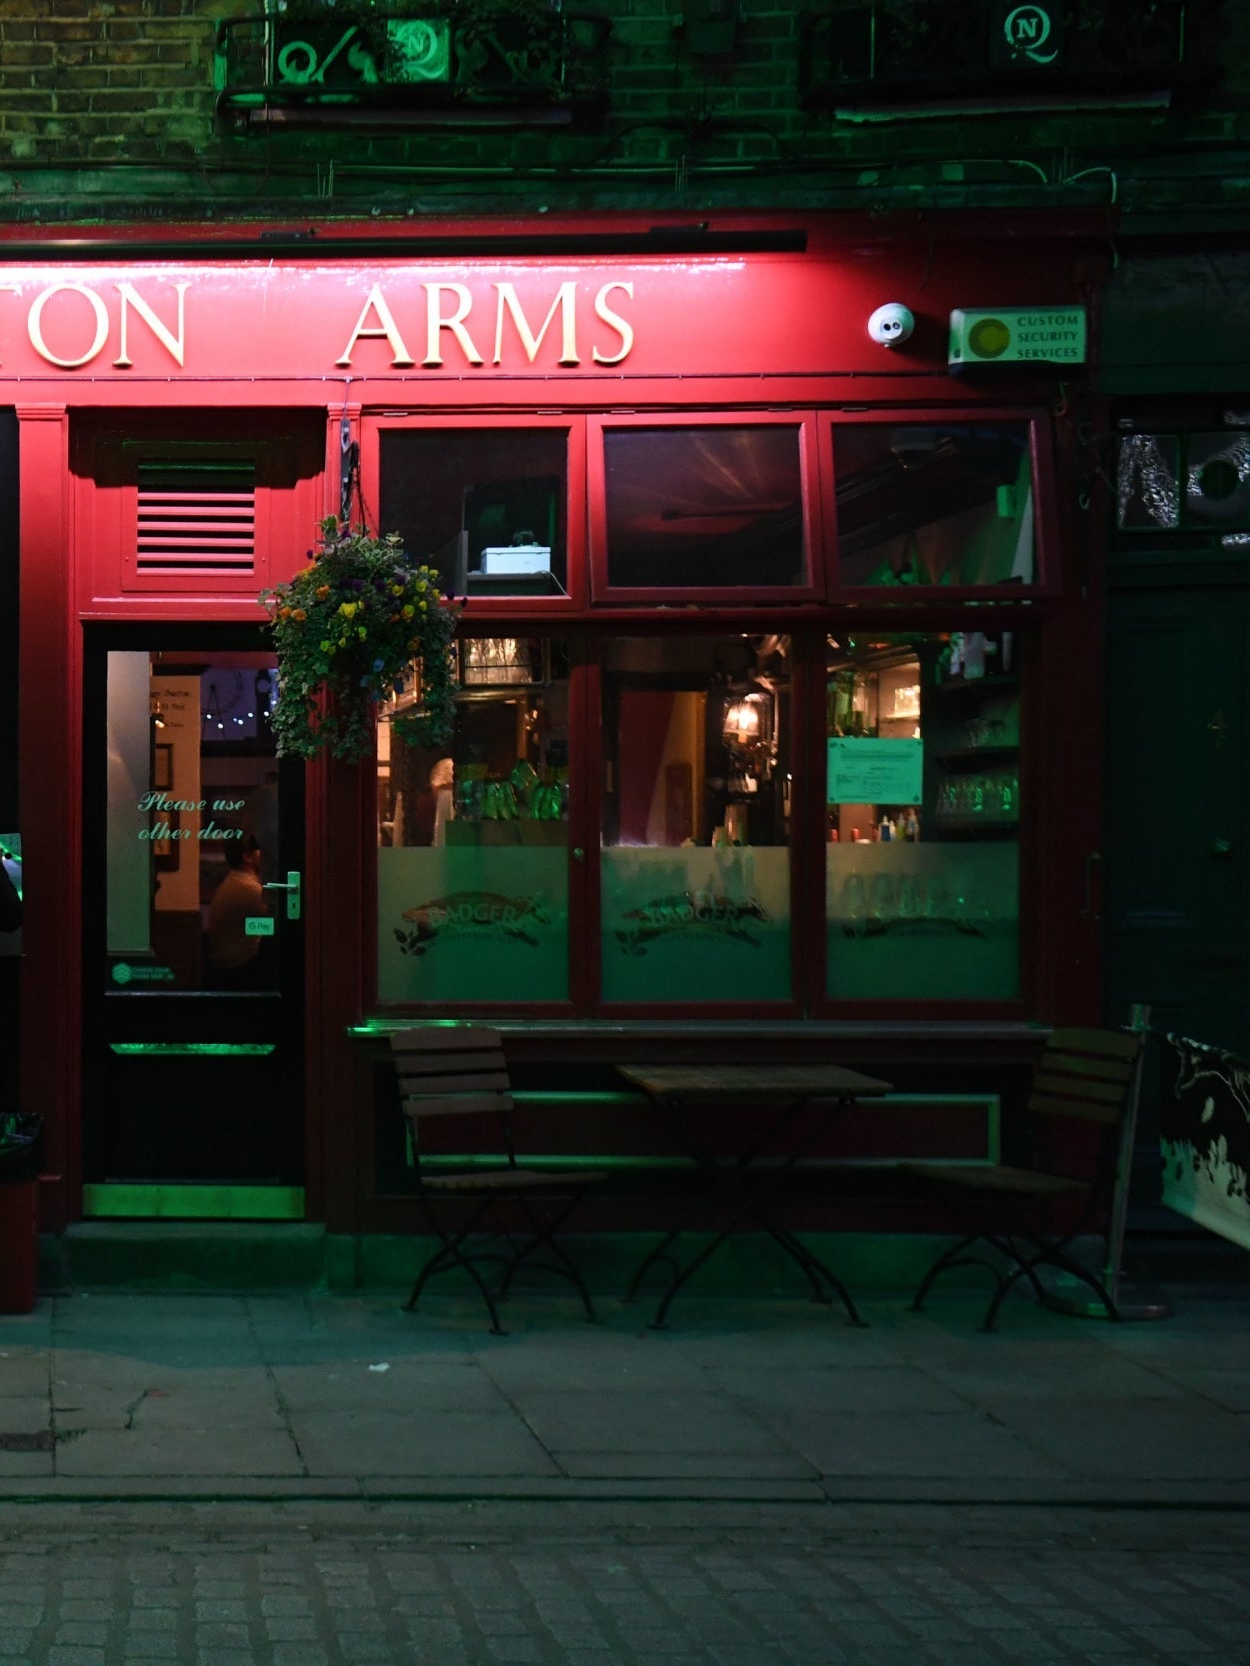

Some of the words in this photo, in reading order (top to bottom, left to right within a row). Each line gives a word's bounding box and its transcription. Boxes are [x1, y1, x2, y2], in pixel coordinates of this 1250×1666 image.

[334, 281, 634, 368] ARMS
[1017, 315, 1078, 326] CUSTOM
[1017, 331, 1078, 342] SECURITY
[1017, 347, 1078, 359] SERVICES
[137, 790, 207, 812] Please
[212, 799, 246, 812] use
[137, 821, 191, 840] other
[197, 820, 244, 840] door
